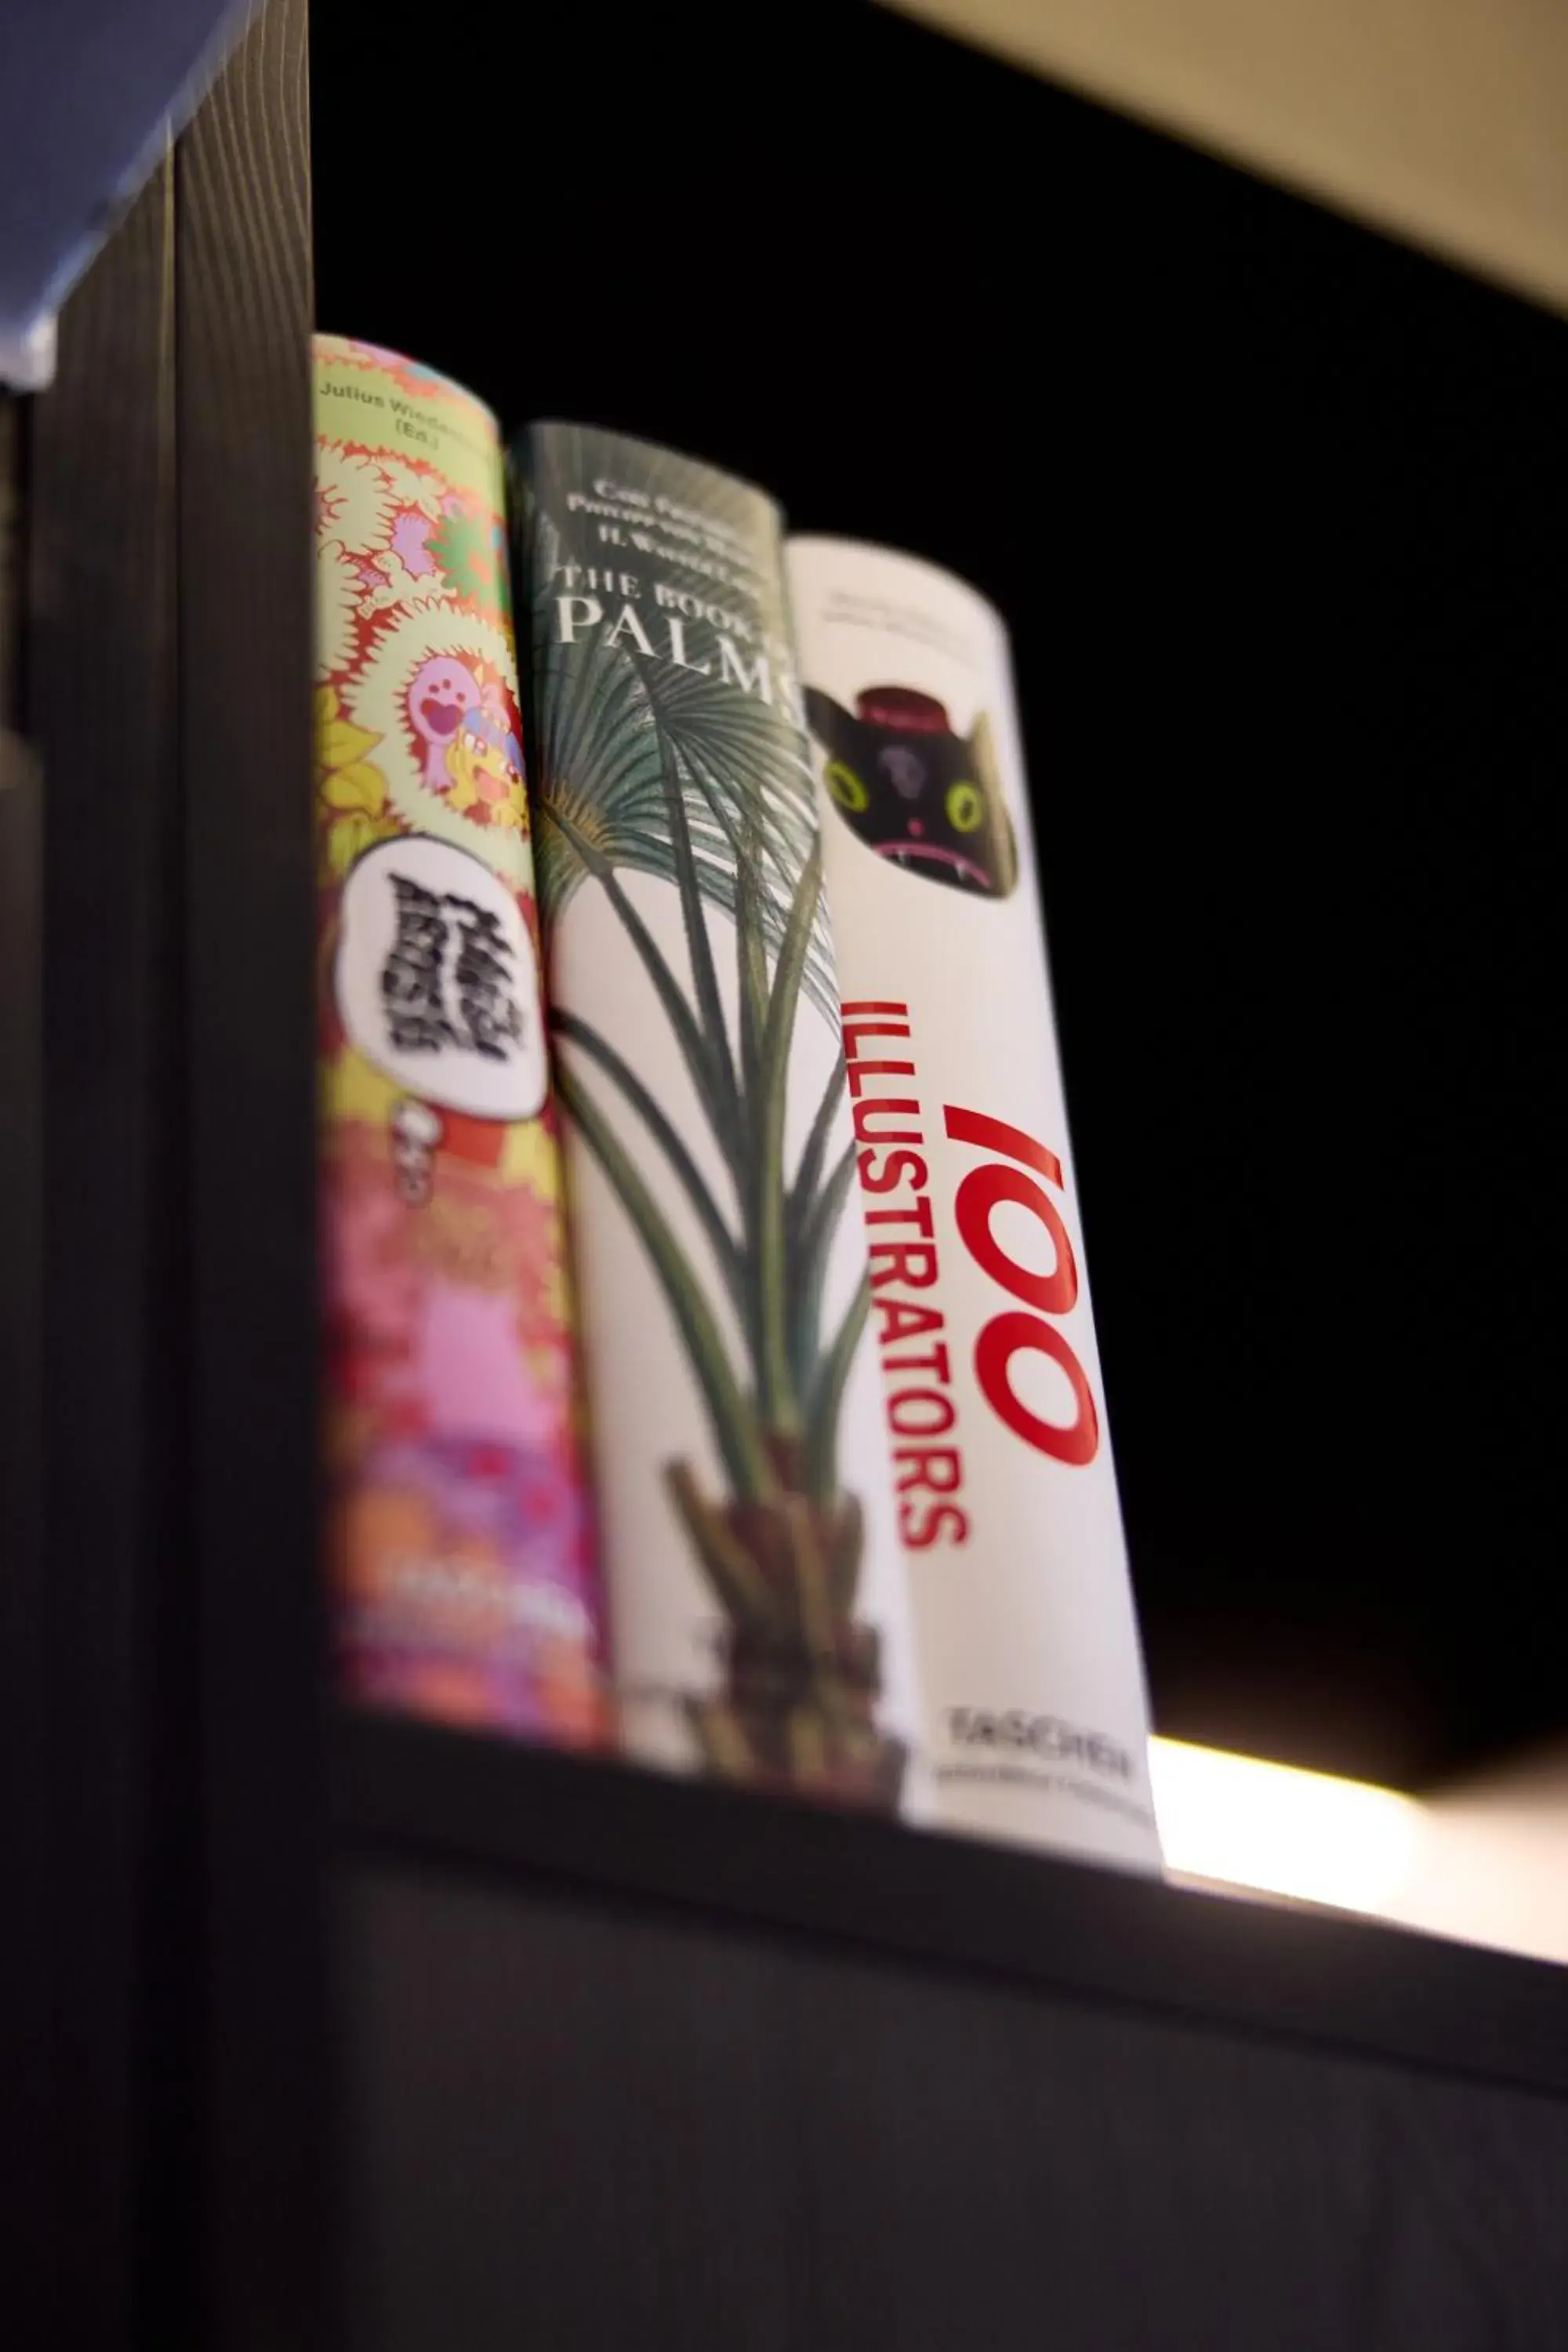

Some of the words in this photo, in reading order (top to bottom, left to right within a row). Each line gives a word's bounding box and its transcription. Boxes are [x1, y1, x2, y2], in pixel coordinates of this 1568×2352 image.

[319, 383, 386, 408] Julius
[554, 564, 642, 601] THE
[840, 1000, 973, 1555] ILLUSTRATORS
[942, 1104, 1099, 1468] 100
